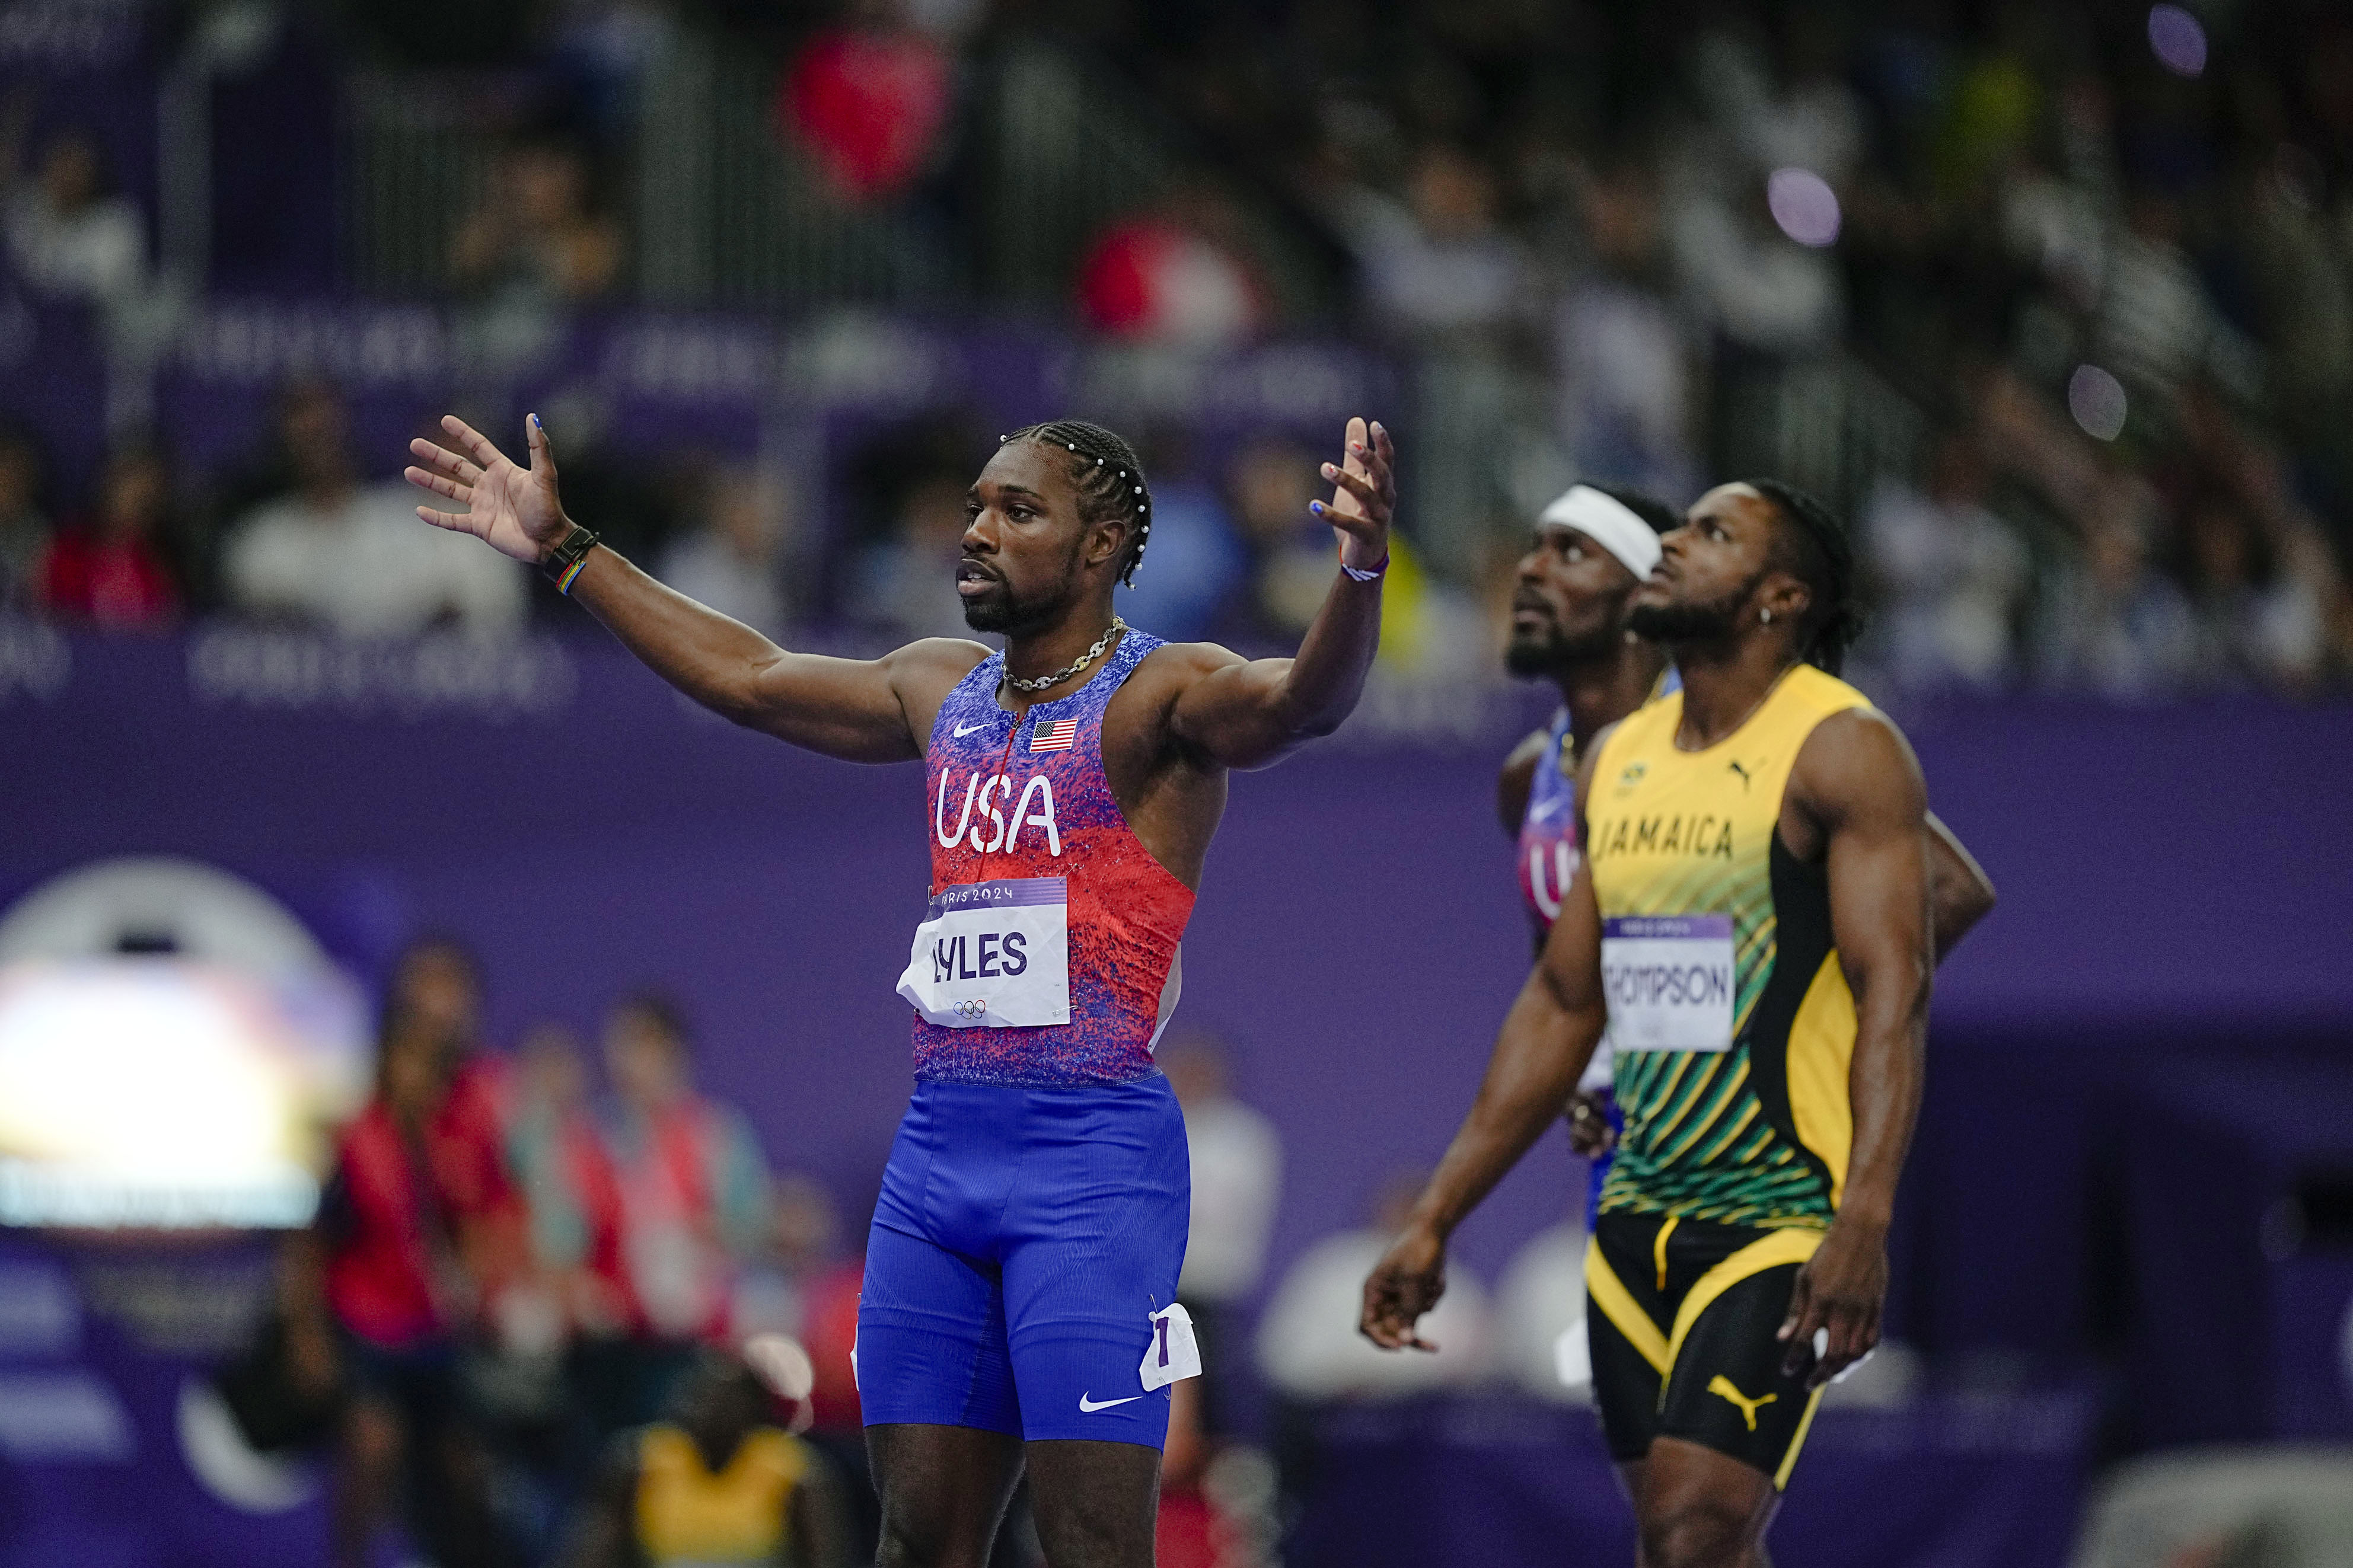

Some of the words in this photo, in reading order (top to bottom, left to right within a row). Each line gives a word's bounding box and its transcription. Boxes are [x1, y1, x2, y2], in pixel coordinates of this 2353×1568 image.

[936, 767, 1061, 857] USA
[1591, 814, 1732, 860] JAMAICA
[973, 887, 1012, 901] 2024
[1155, 1316, 1169, 1368] 1
